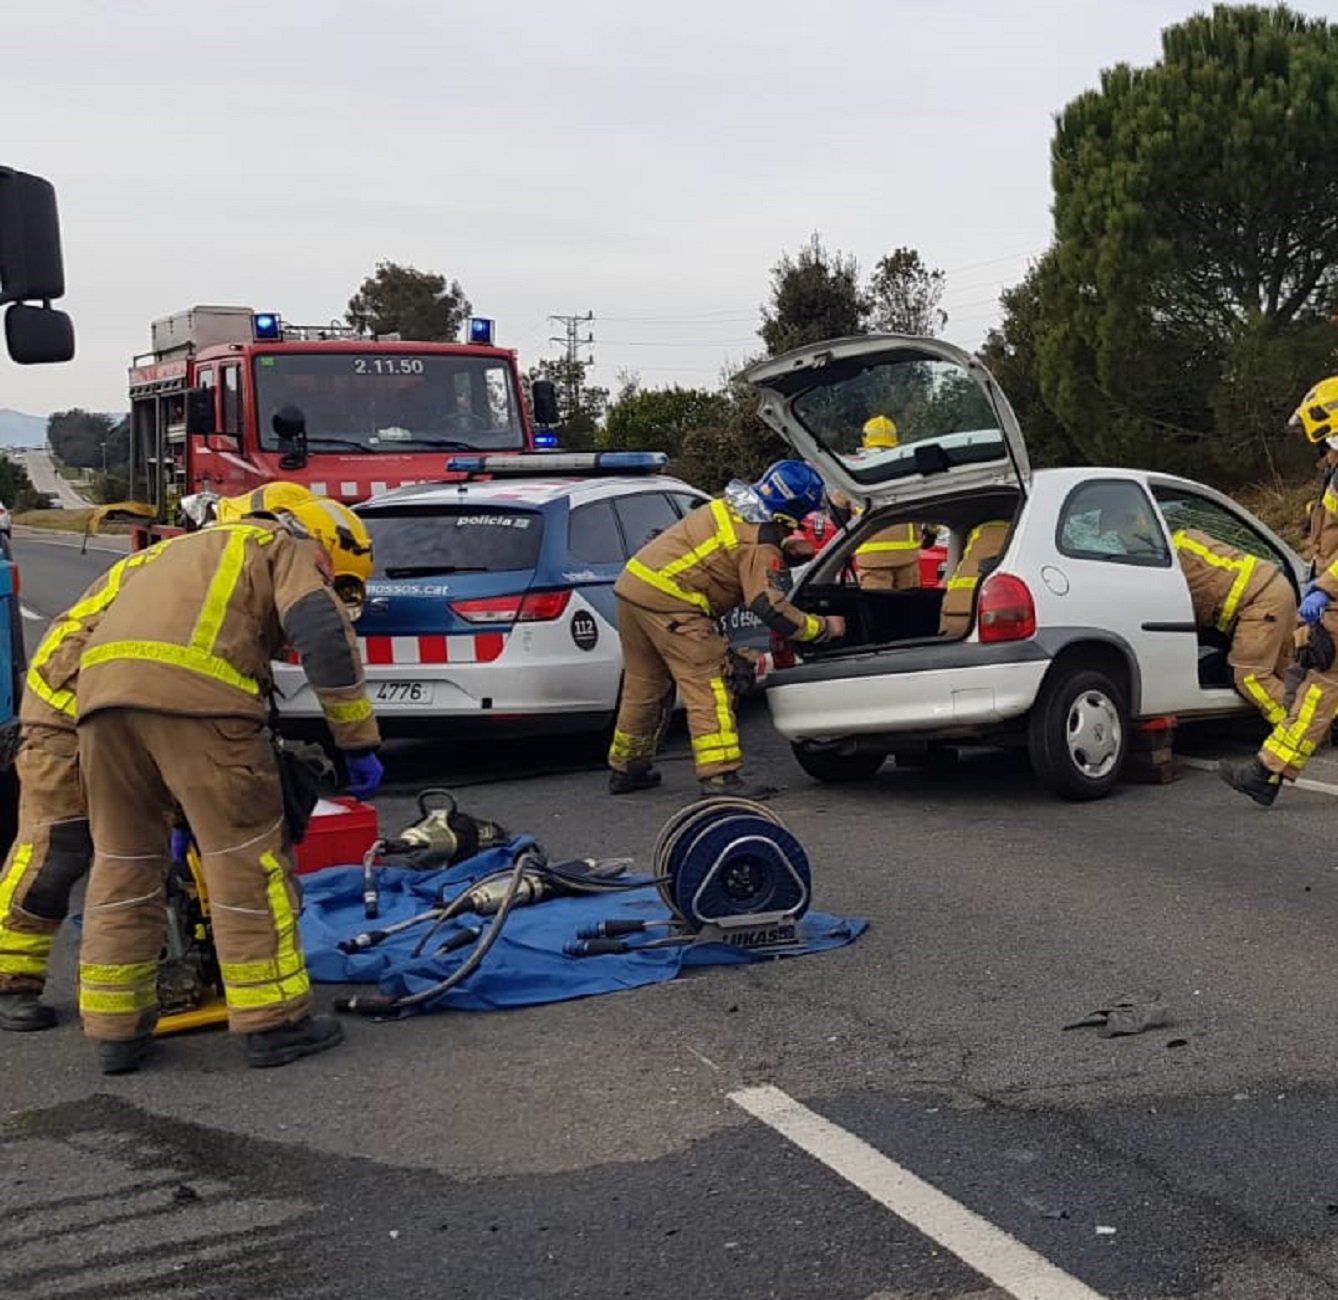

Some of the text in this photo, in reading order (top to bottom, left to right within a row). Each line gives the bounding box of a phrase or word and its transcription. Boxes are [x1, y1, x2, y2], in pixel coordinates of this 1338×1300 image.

[354, 359, 424, 374] 2.11.50
[574, 620, 595, 635] 112
[376, 683, 423, 700] 4776
